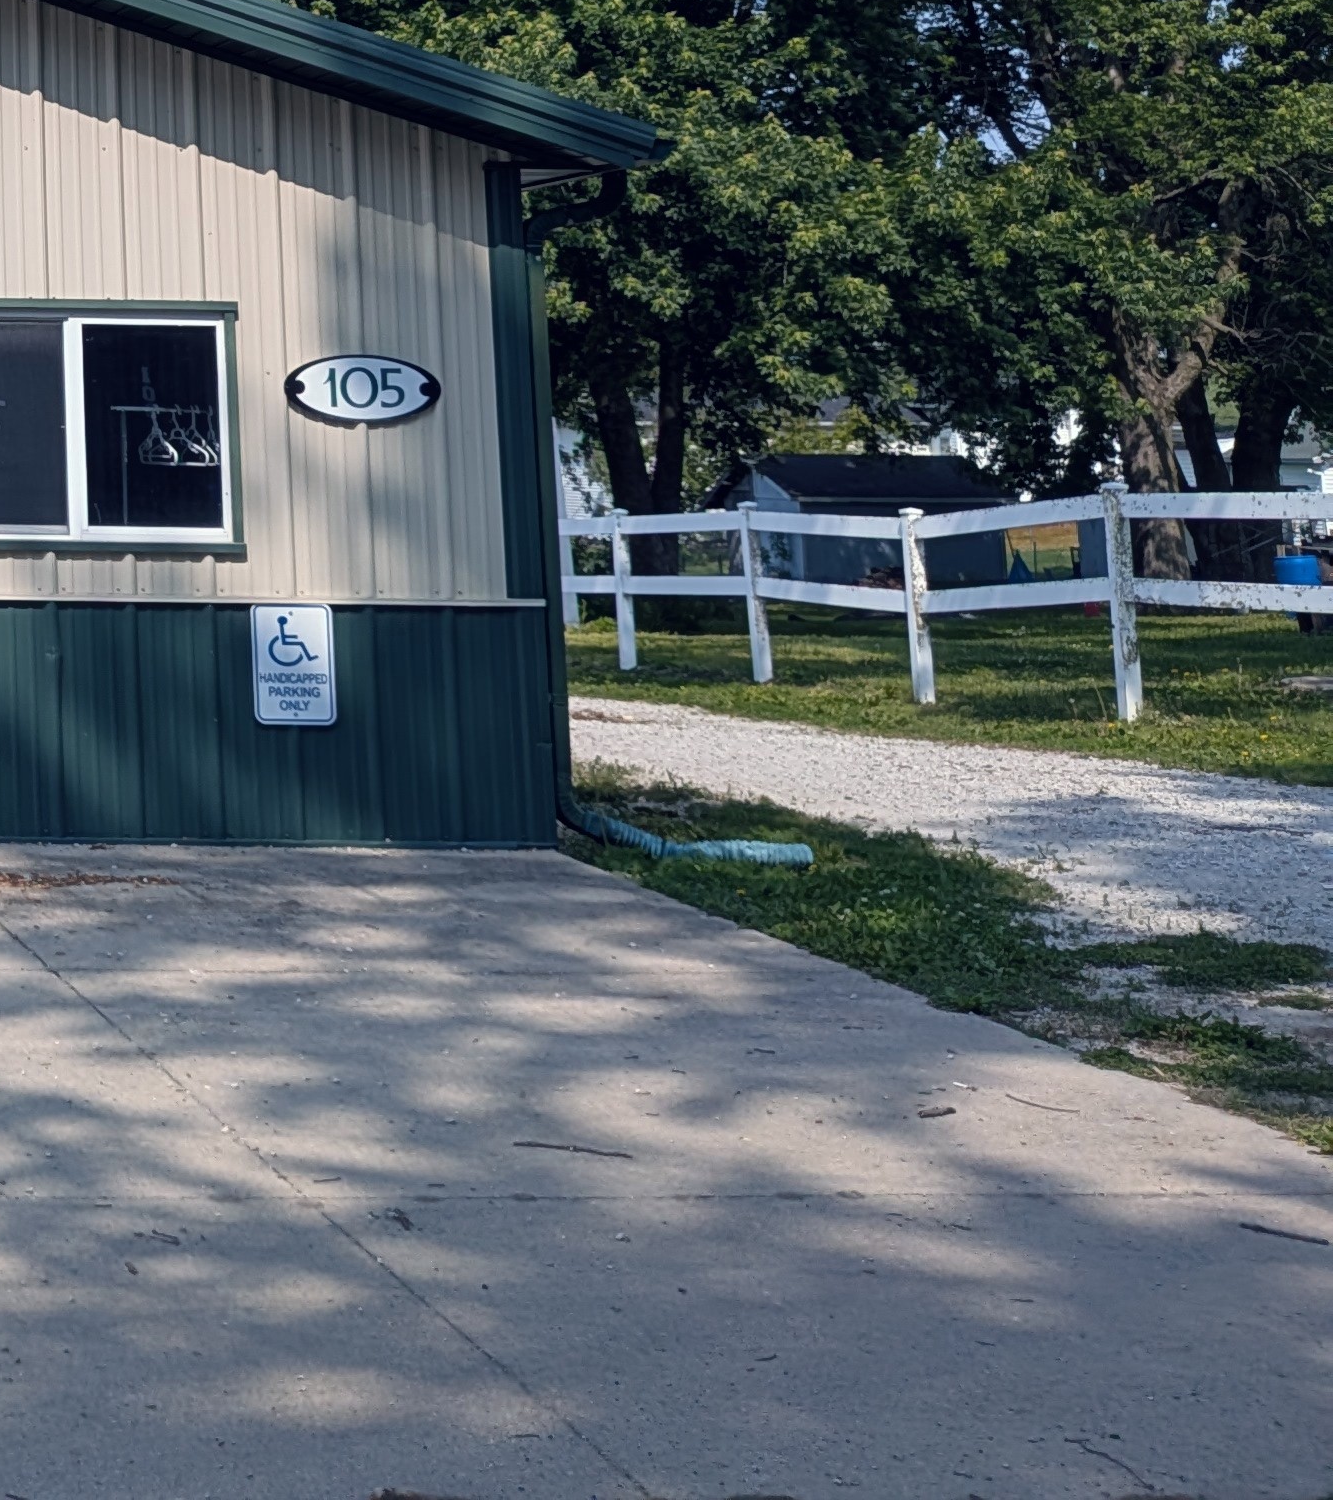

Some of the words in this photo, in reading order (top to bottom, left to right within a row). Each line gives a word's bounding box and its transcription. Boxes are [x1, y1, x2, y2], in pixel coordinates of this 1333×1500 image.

[323, 366, 405, 409] 105
[259, 673, 328, 685] HANDICAPPED
[268, 686, 321, 698] PARKING
[279, 700, 310, 711] ONLY
